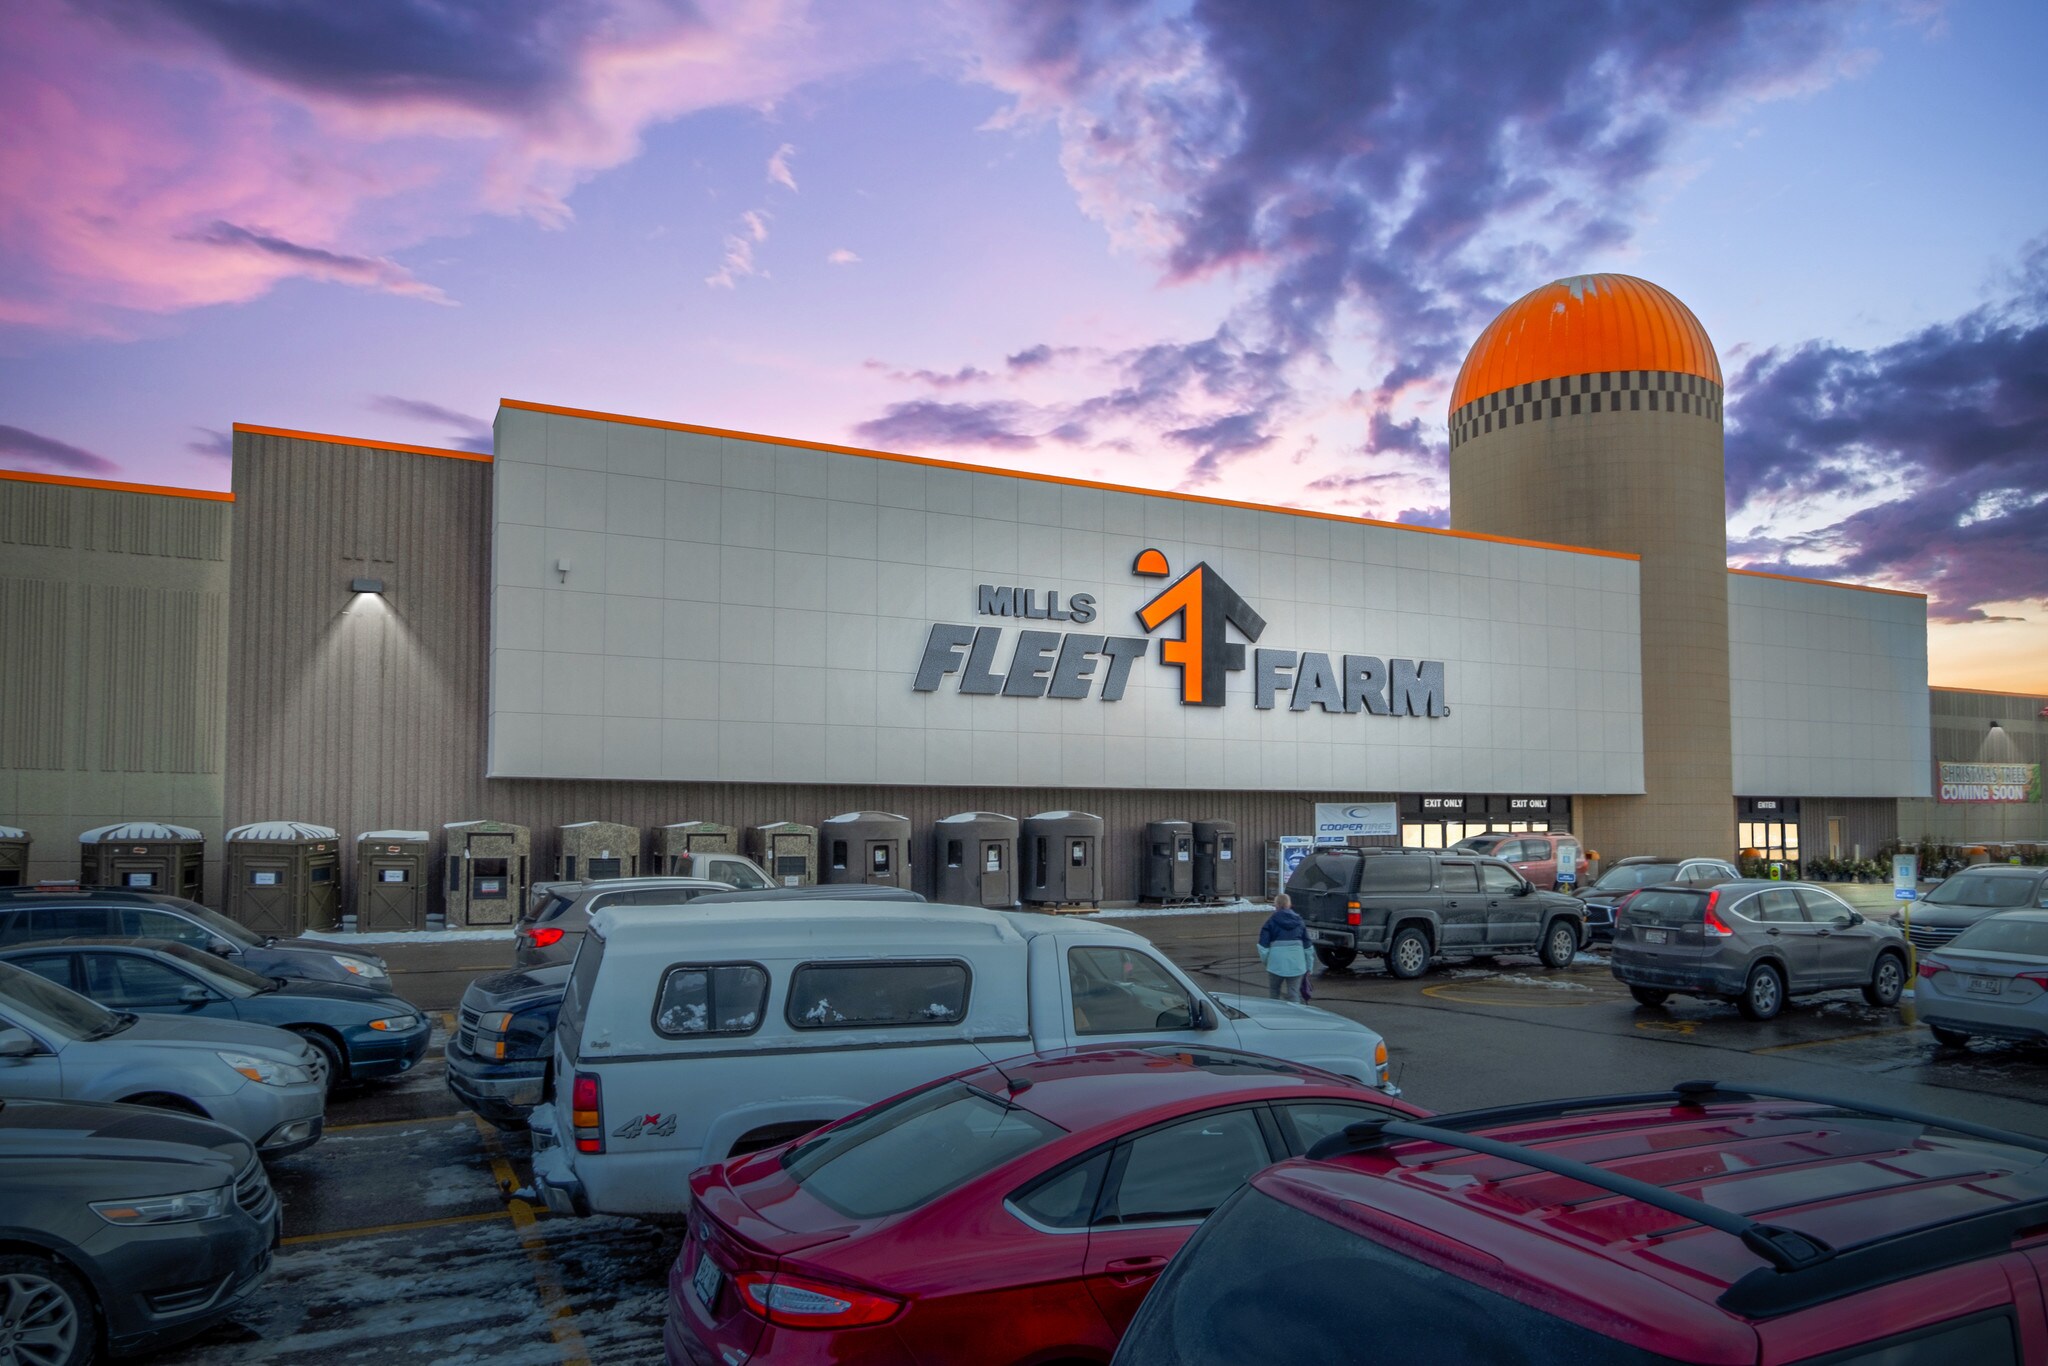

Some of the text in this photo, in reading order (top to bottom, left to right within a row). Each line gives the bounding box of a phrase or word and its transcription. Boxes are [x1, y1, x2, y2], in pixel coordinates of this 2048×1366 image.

[978, 584, 1097, 624] MILLS
[912, 622, 1149, 701] FLEET
[1942, 765, 2027, 783] CHRISTMAS TREES
[1941, 784, 2023, 800] COMING SOON
[1424, 798, 1463, 808] EXIT ONLY
[1511, 799, 1548, 808] EXIT ONLY
[1757, 801, 1776, 809] ENTER
